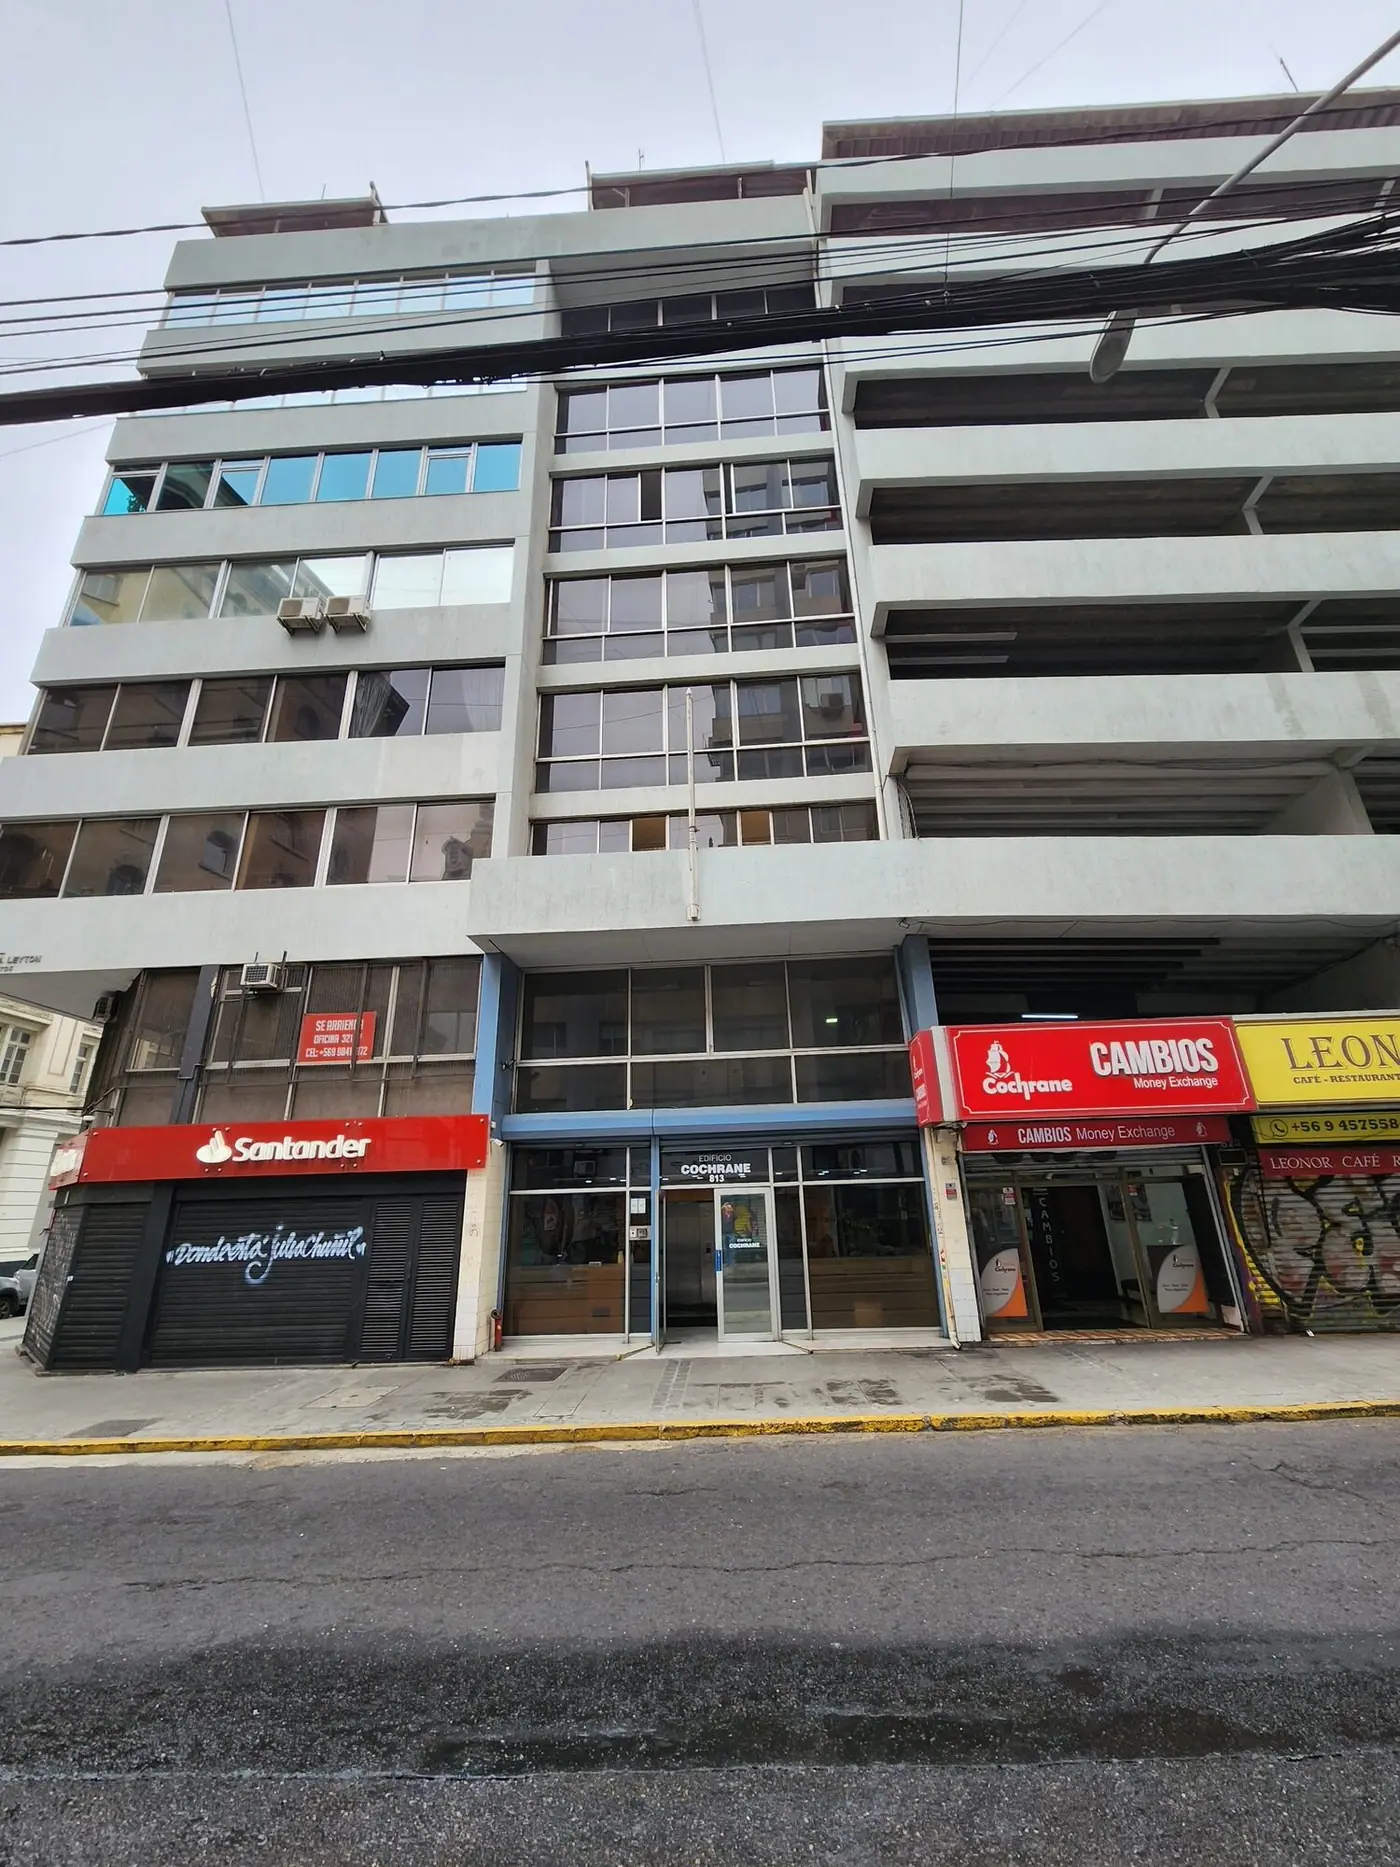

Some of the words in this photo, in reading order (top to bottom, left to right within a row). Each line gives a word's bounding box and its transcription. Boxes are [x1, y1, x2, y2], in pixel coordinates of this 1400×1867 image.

[316, 1020, 326, 1031] SE
[313, 1034, 340, 1044] OFICINA
[1090, 1037, 1219, 1077] CAMBIOS
[1281, 1033, 1400, 1070] LEON
[982, 1072, 1073, 1100] Cochrane
[1134, 1077, 1167, 1090] Money
[1169, 1075, 1218, 1089] Exchange
[1293, 1074, 1321, 1084] CAFÉ
[1017, 1126, 1072, 1144] CAMBIOS
[1076, 1126, 1115, 1142] Money
[1119, 1123, 1175, 1142] Exchange
[1292, 1121, 1321, 1132] +56
[1324, 1120, 1334, 1131] 9
[232, 1134, 372, 1162] Santander
[698, 1154, 732, 1162] EDIFICIO
[1270, 1156, 1334, 1169] LEONOR
[1342, 1152, 1380, 1168] CAFÉ
[681, 1163, 751, 1174] COCHRANE
[709, 1174, 725, 1182] 813
[1039, 1198, 1060, 1282] CAMBIOS
